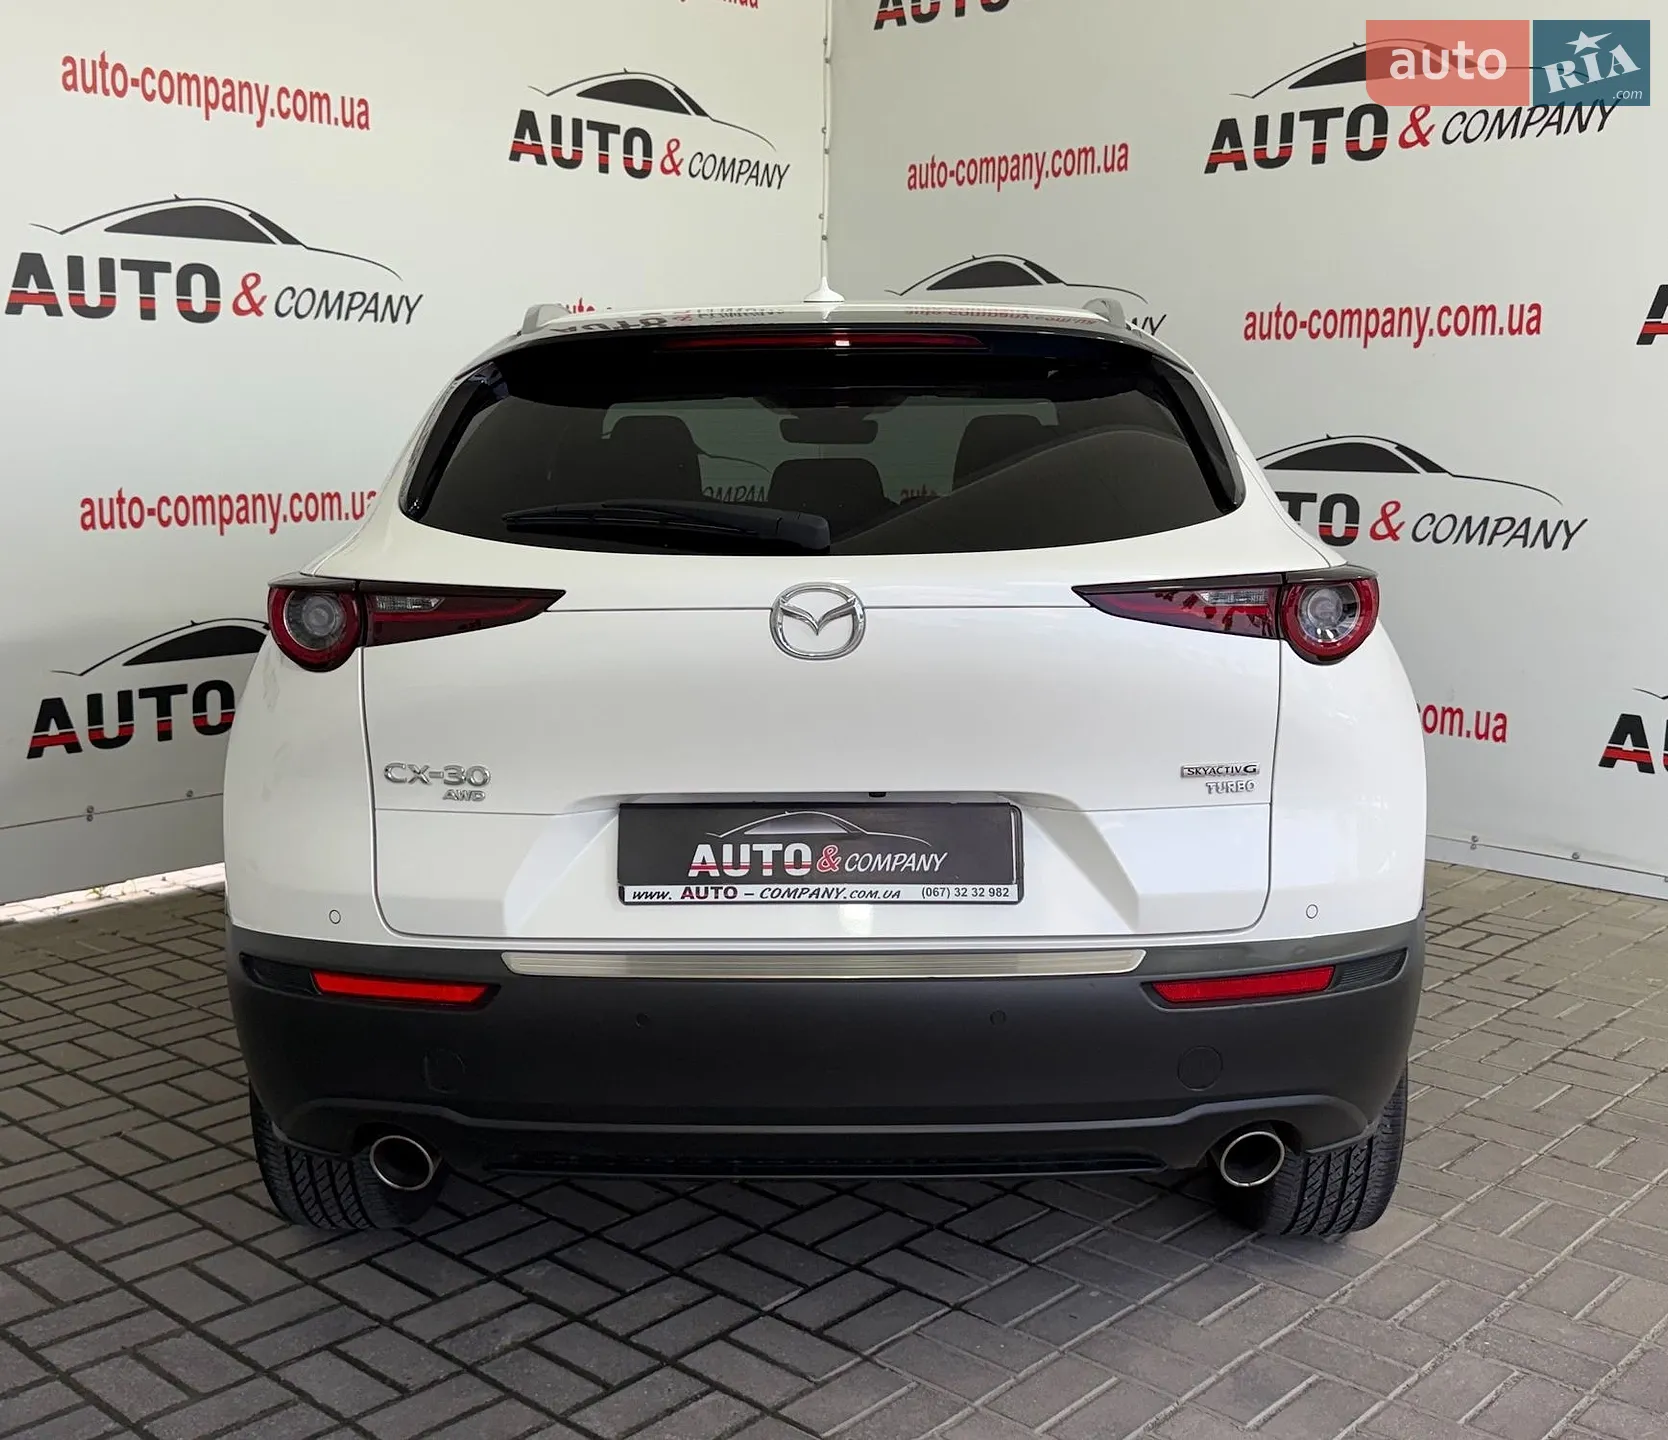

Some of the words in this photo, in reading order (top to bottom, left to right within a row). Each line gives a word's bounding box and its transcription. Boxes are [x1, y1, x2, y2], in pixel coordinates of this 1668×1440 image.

[62, 50, 370, 131] auto-company.com.ua
[508, 109, 653, 180] AUTO
[659, 138, 684, 177] &
[688, 151, 790, 190] COMPANY
[1203, 103, 1389, 174] AUTO
[1398, 104, 1436, 149] &
[1441, 98, 1623, 145] COMPANY
[907, 142, 1129, 192] auto-company.com.ua
[5, 252, 222, 324] AUTO
[232, 272, 268, 318] &
[274, 286, 424, 325] COMPANY
[1243, 302, 1542, 349] auto-company.com.ua
[1274, 491, 1360, 547] TO
[1369, 500, 1406, 542] &
[1411, 513, 1588, 551] COMPANY
[27, 680, 235, 760] AUTO
[384, 762, 492, 787] CX-30
[442, 788, 486, 802] AWD
[1205, 779, 1255, 795] TURBO
[687, 842, 813, 877] AUTO
[816, 844, 841, 874] &
[844, 852, 948, 873] COMPANY
[680, 886, 738, 900] AUTO
[921, 887, 951, 899] (067)
[954, 887, 969, 897] 32
[971, 887, 985, 897] 32
[988, 887, 1010, 897] 982
